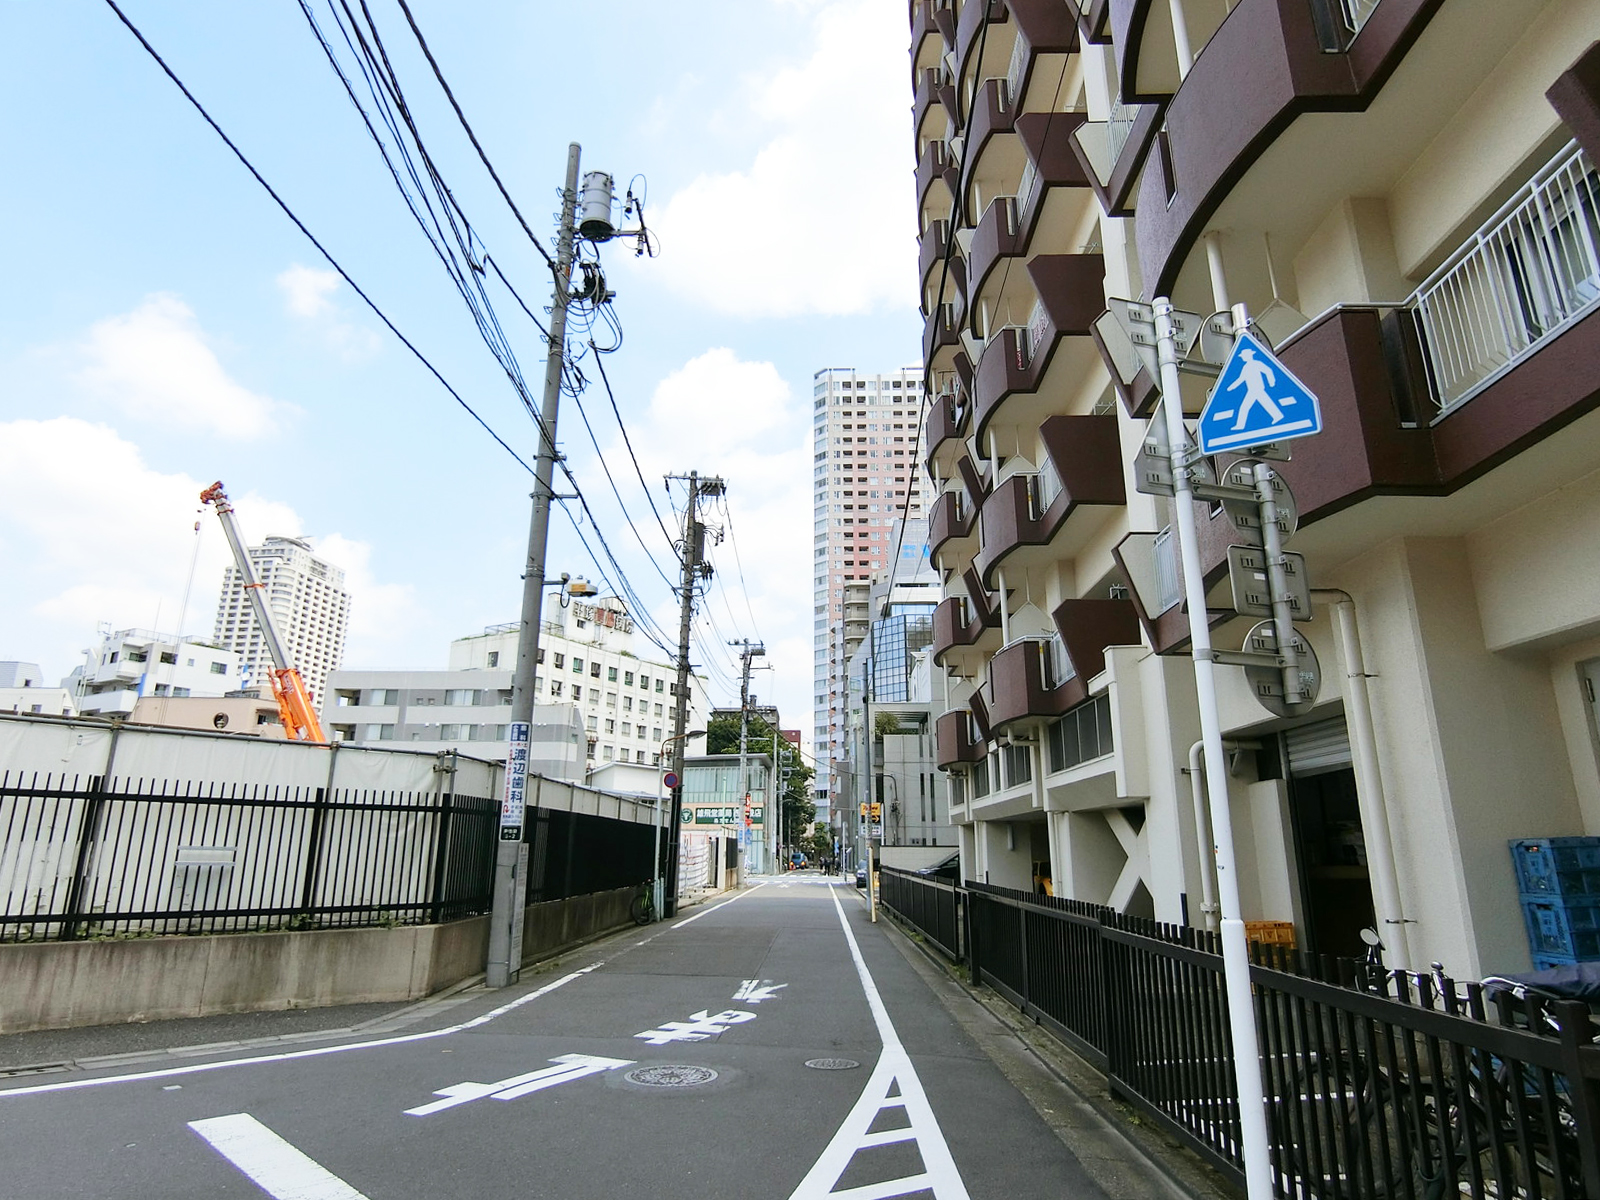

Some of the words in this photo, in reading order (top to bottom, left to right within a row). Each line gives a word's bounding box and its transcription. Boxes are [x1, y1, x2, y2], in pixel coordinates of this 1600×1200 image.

[510, 748, 527, 803] 渡辺歯科
[402, 979, 789, 1117] 止まれ
